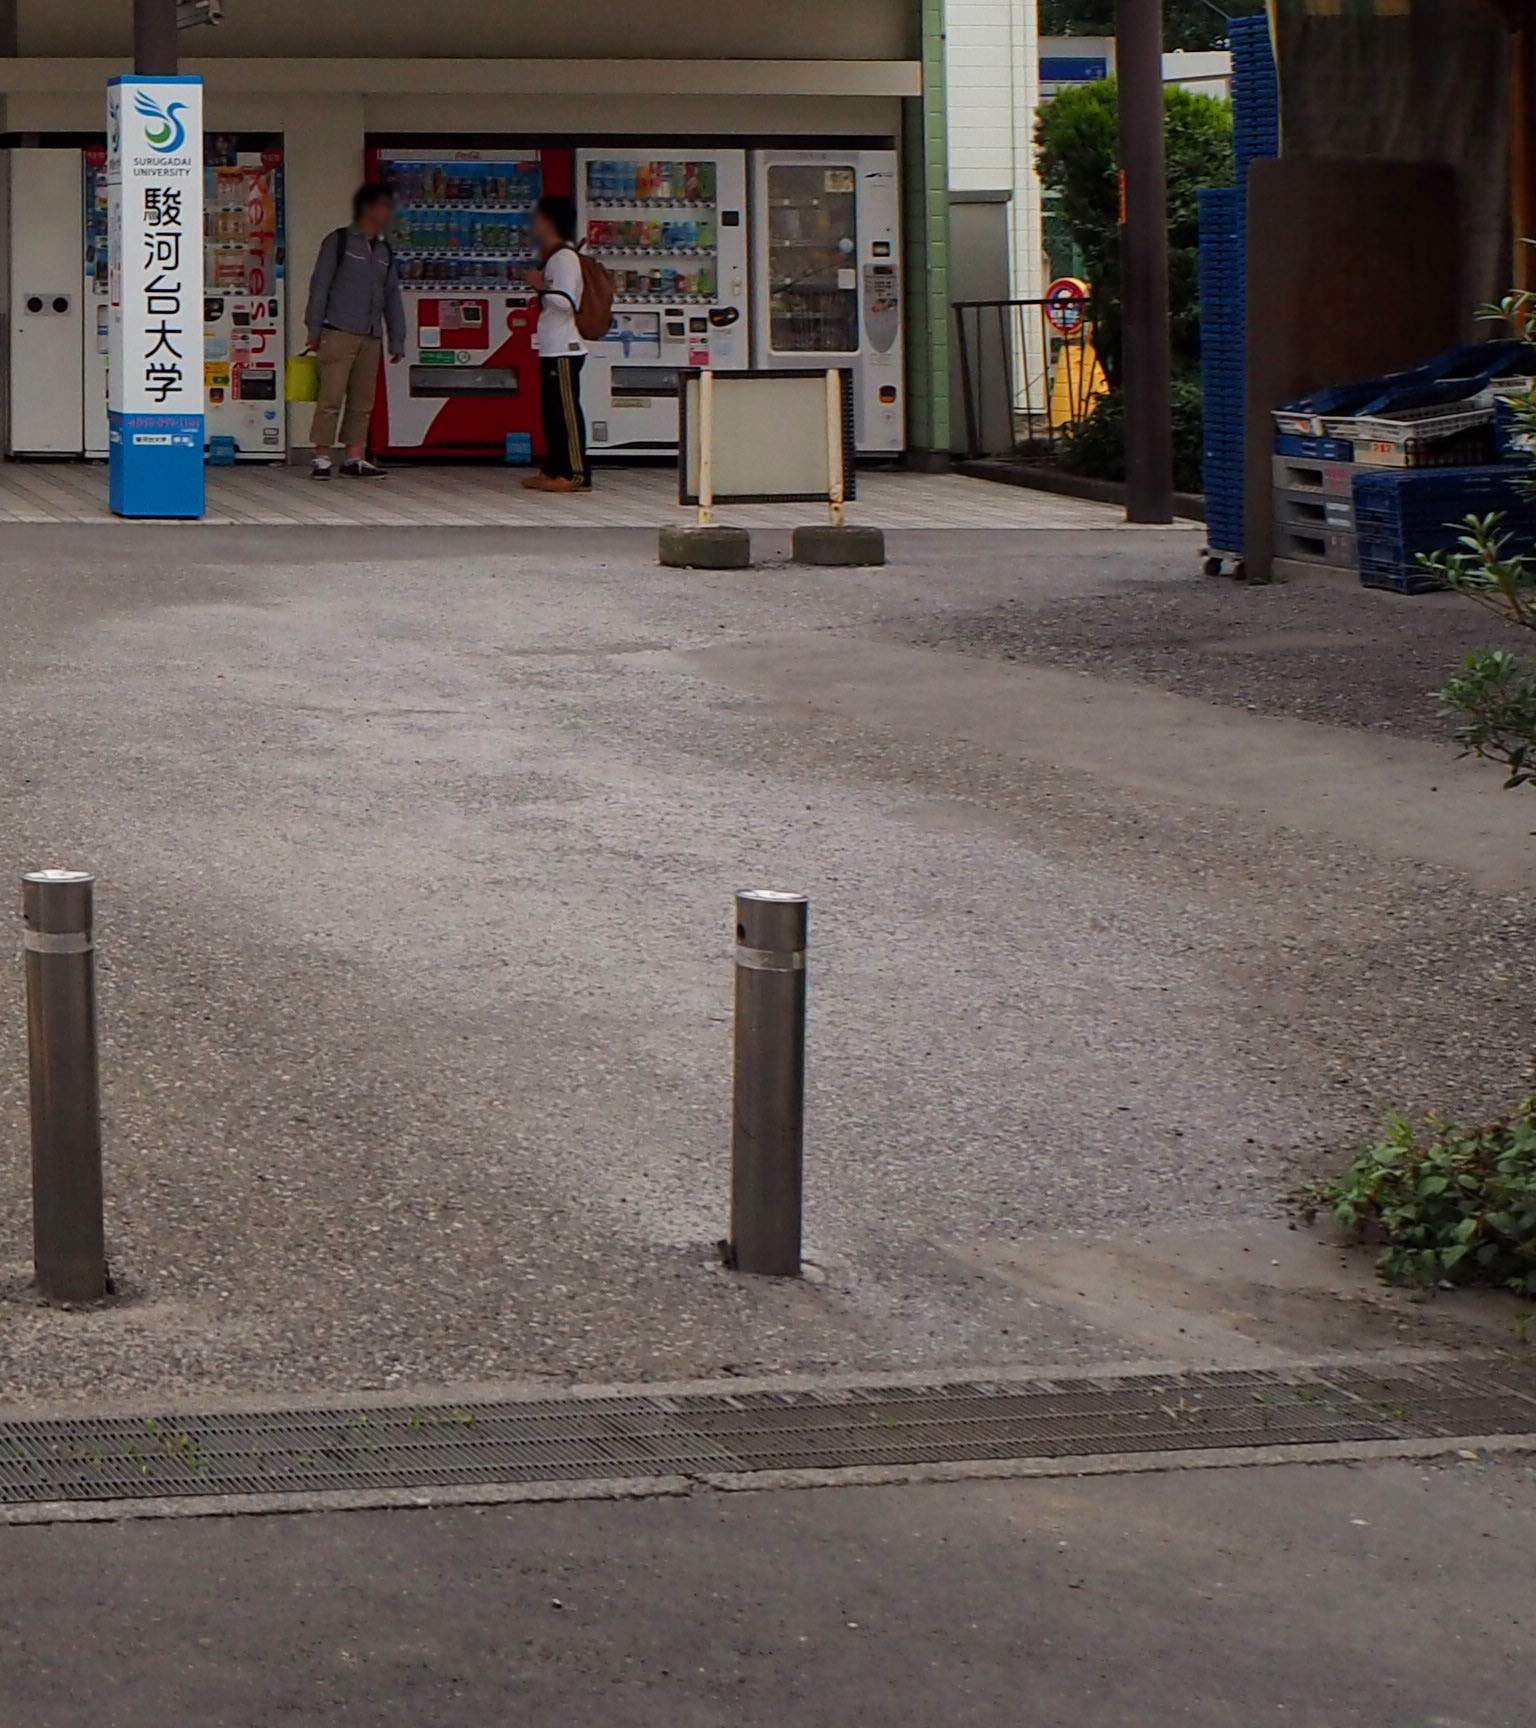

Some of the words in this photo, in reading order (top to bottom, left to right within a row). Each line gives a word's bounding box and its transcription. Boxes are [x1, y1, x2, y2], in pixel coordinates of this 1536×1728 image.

[133, 158, 192, 166] SURUGADAI
[133, 168, 191, 176] UNIVERSITY
[143, 186, 183, 402] 駿河台大学
